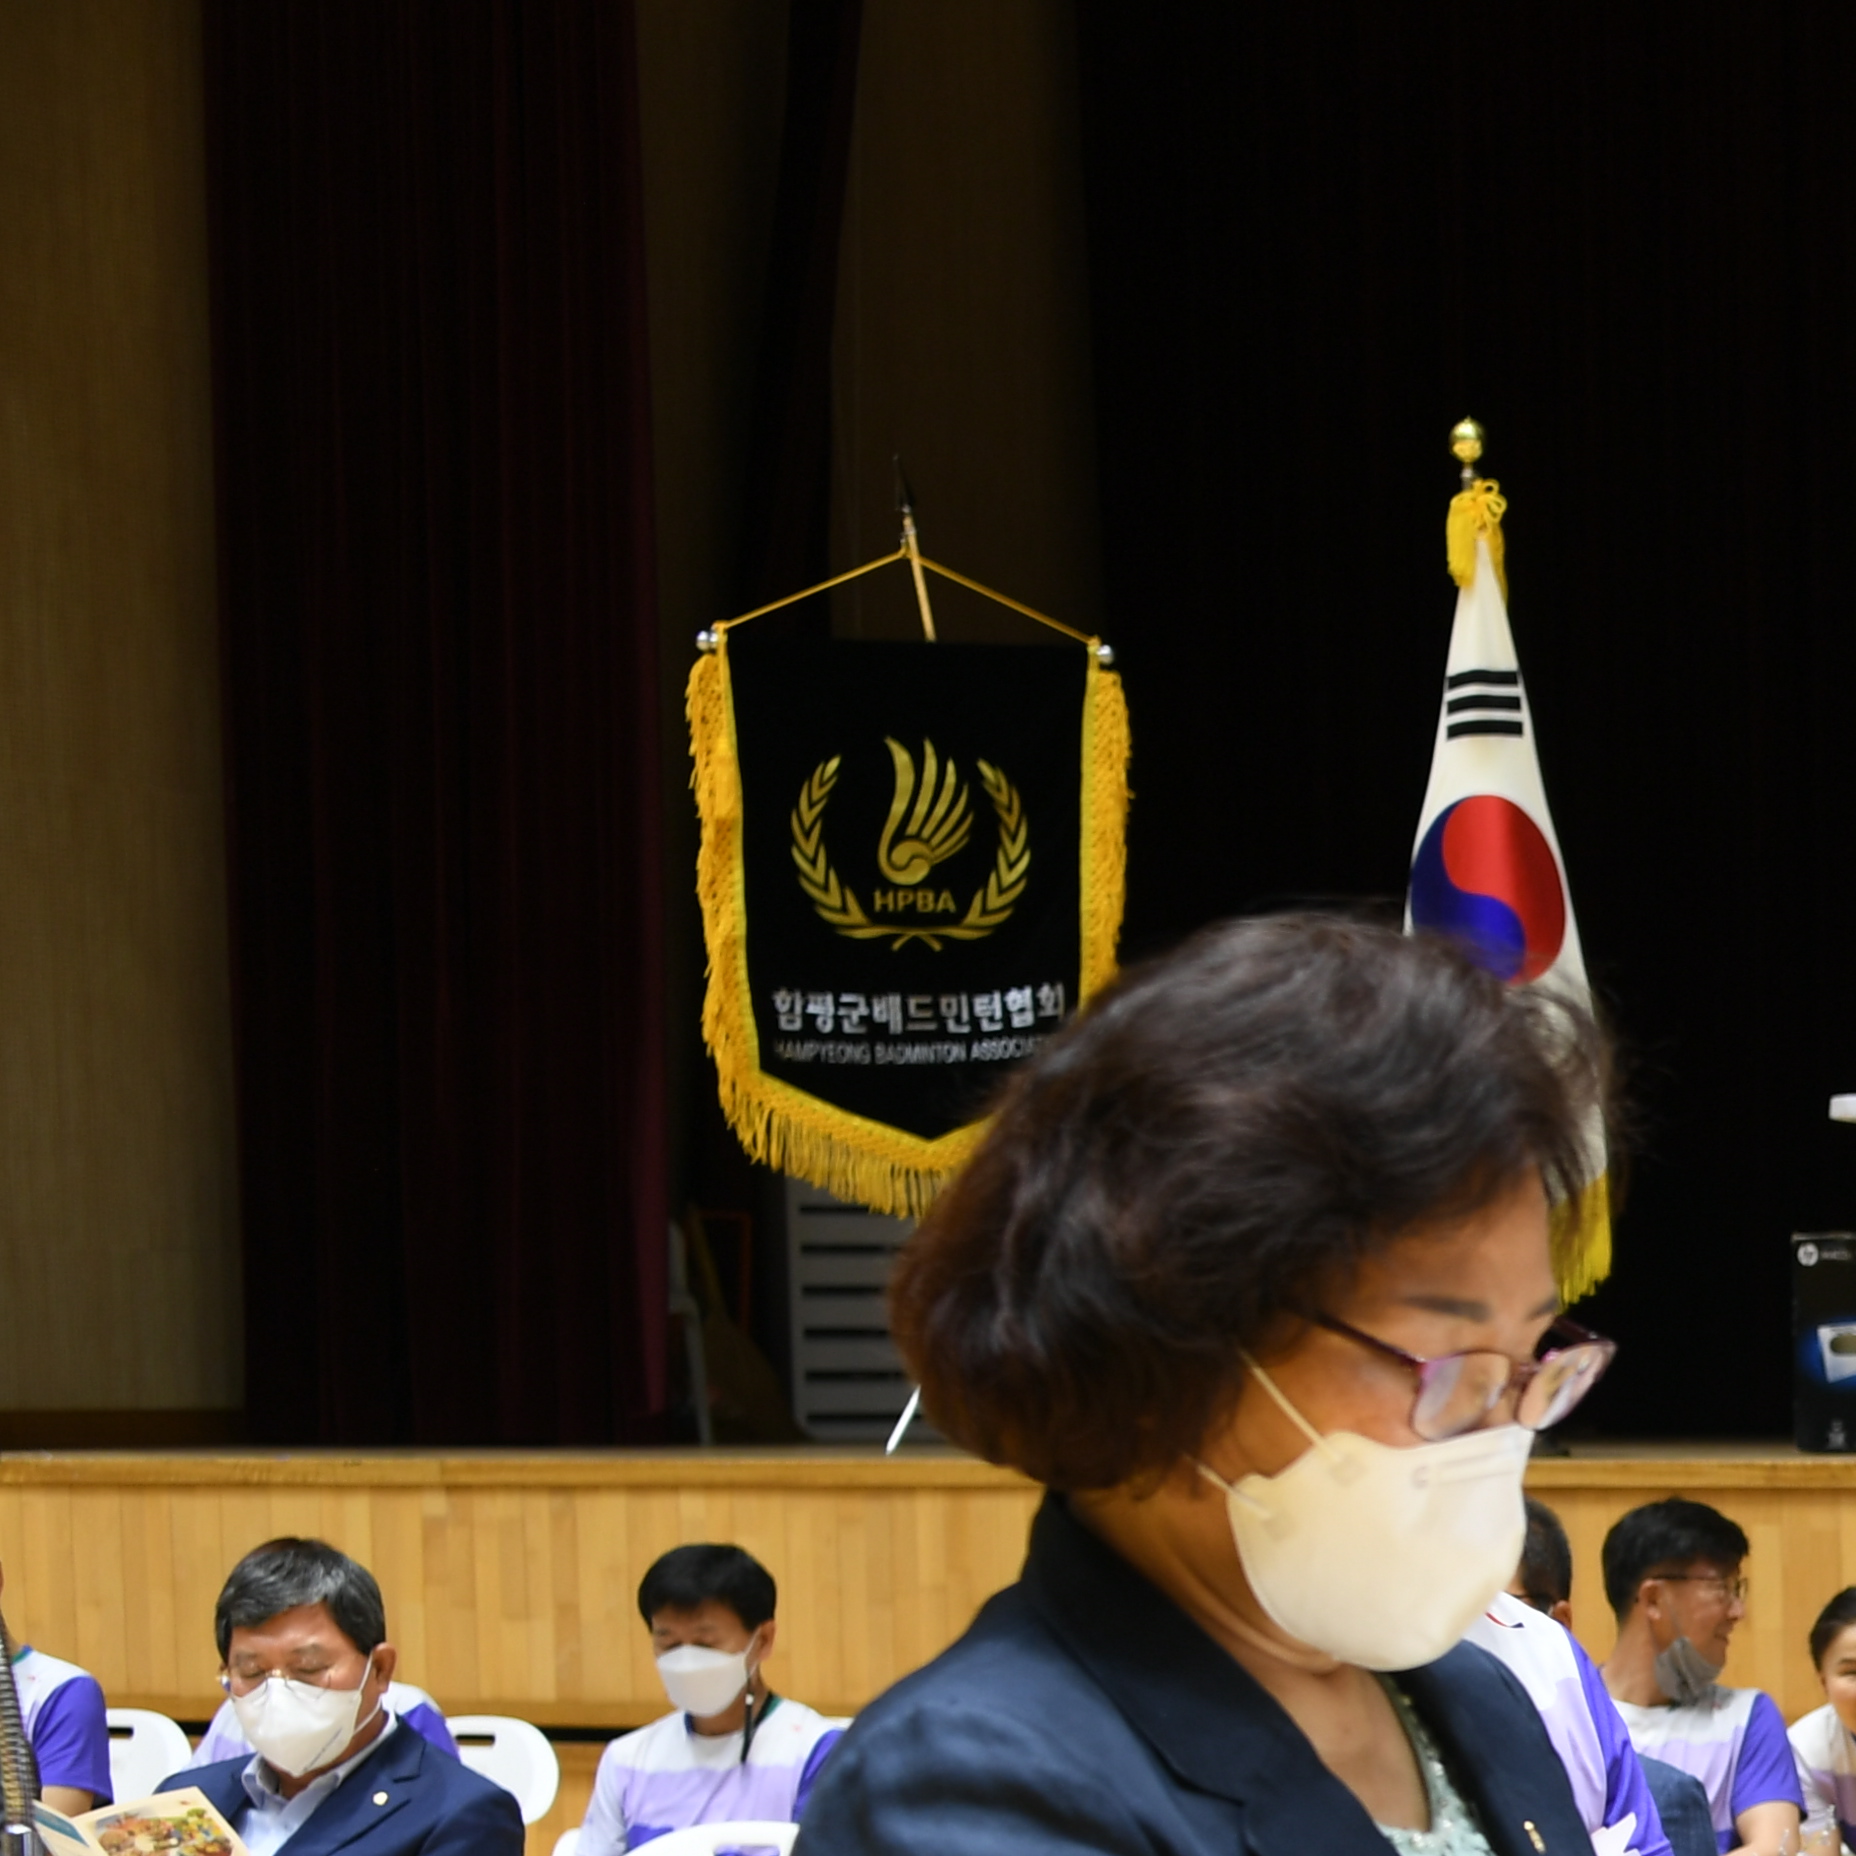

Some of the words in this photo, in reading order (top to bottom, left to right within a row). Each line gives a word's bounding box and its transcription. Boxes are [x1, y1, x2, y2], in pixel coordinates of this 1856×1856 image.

[874, 889, 956, 912] HPBA
[773, 981, 1066, 1035] 함평군배드민턴협회
[776, 1040, 870, 1064] HAMPYEONG
[874, 1040, 967, 1064] BADMINTON
